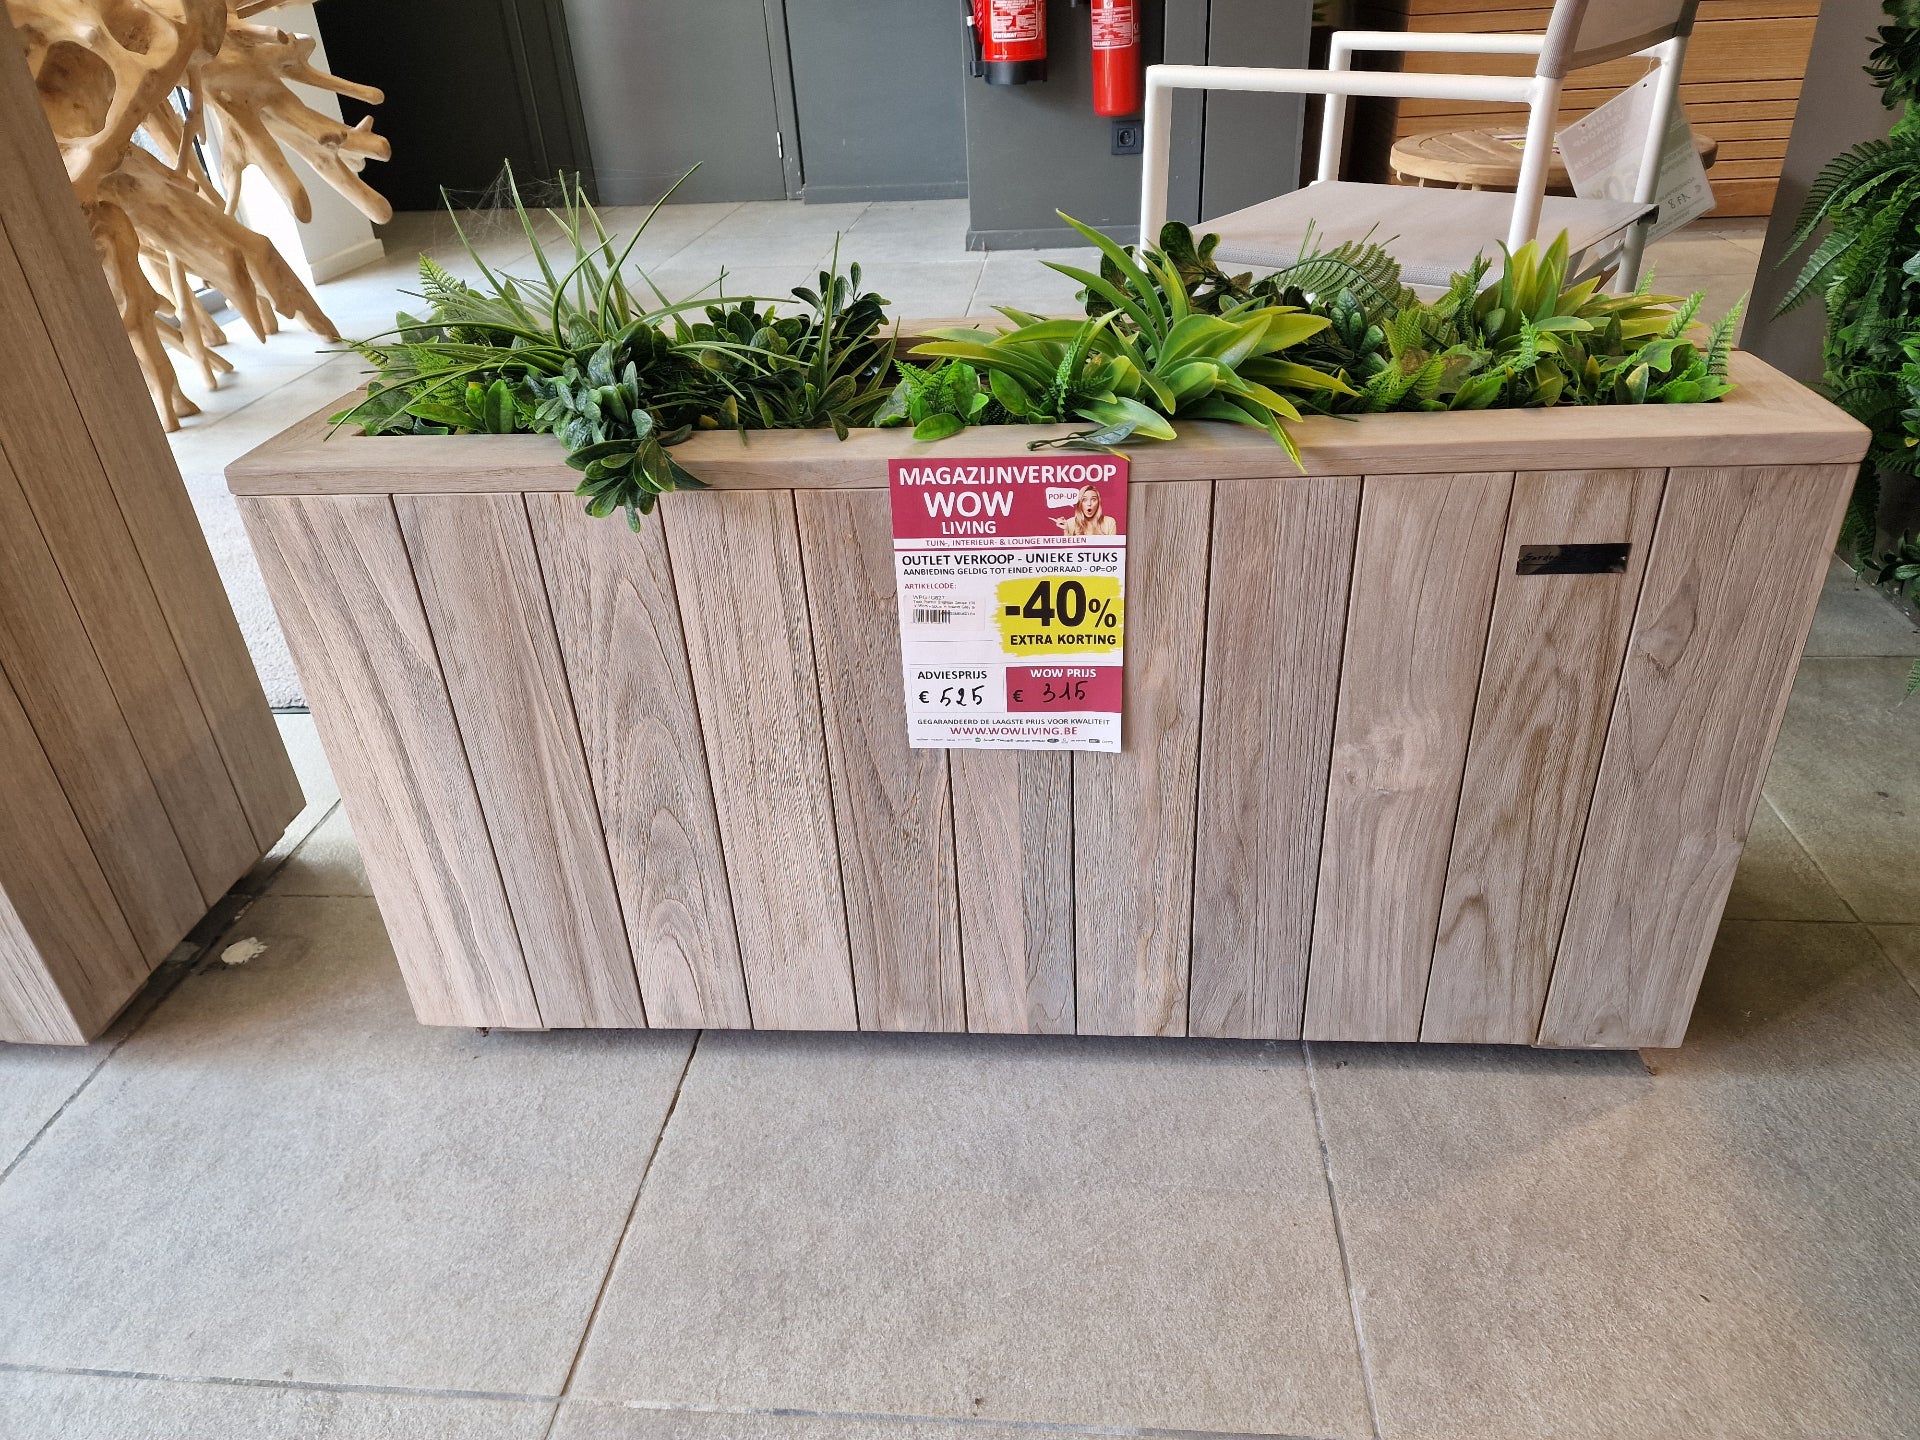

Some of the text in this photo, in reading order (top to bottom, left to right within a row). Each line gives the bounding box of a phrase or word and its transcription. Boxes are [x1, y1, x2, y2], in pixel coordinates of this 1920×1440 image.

[900, 464, 1117, 485] MAGAZIJNVERKOOP
[1048, 492, 1078, 500] POP-UP
[924, 491, 1014, 518] WOW
[942, 521, 997, 535] LIVING
[1043, 537, 1087, 545] MEUBELEN
[902, 554, 951, 566] OUTLET
[954, 553, 1015, 565] VERKOOP
[1025, 552, 1074, 564] UNIEKE
[1078, 552, 1118, 563] STUKS
[903, 567, 955, 576] AANBIEDING
[957, 567, 988, 575] GELDIG
[989, 567, 1006, 575] TOT
[1008, 566, 1033, 574] EINDE
[1035, 566, 1082, 574] VOORRAAD
[904, 582, 957, 590] ARTIKELCODE:
[1005, 580, 1117, 628] -40%
[1010, 634, 1117, 646] EXTRA KORTING
[917, 671, 988, 680] ADVIESPRIJS
[1030, 668, 1097, 679] WOW PRIJS
[918, 691, 930, 704] €
[939, 685, 985, 707] 525
[1013, 690, 1024, 703] €
[1043, 681, 1089, 703] 315
[1070, 718, 1111, 726] KWALITEIT
[949, 726, 1078, 736] WWW.WOWLIVING.BE
